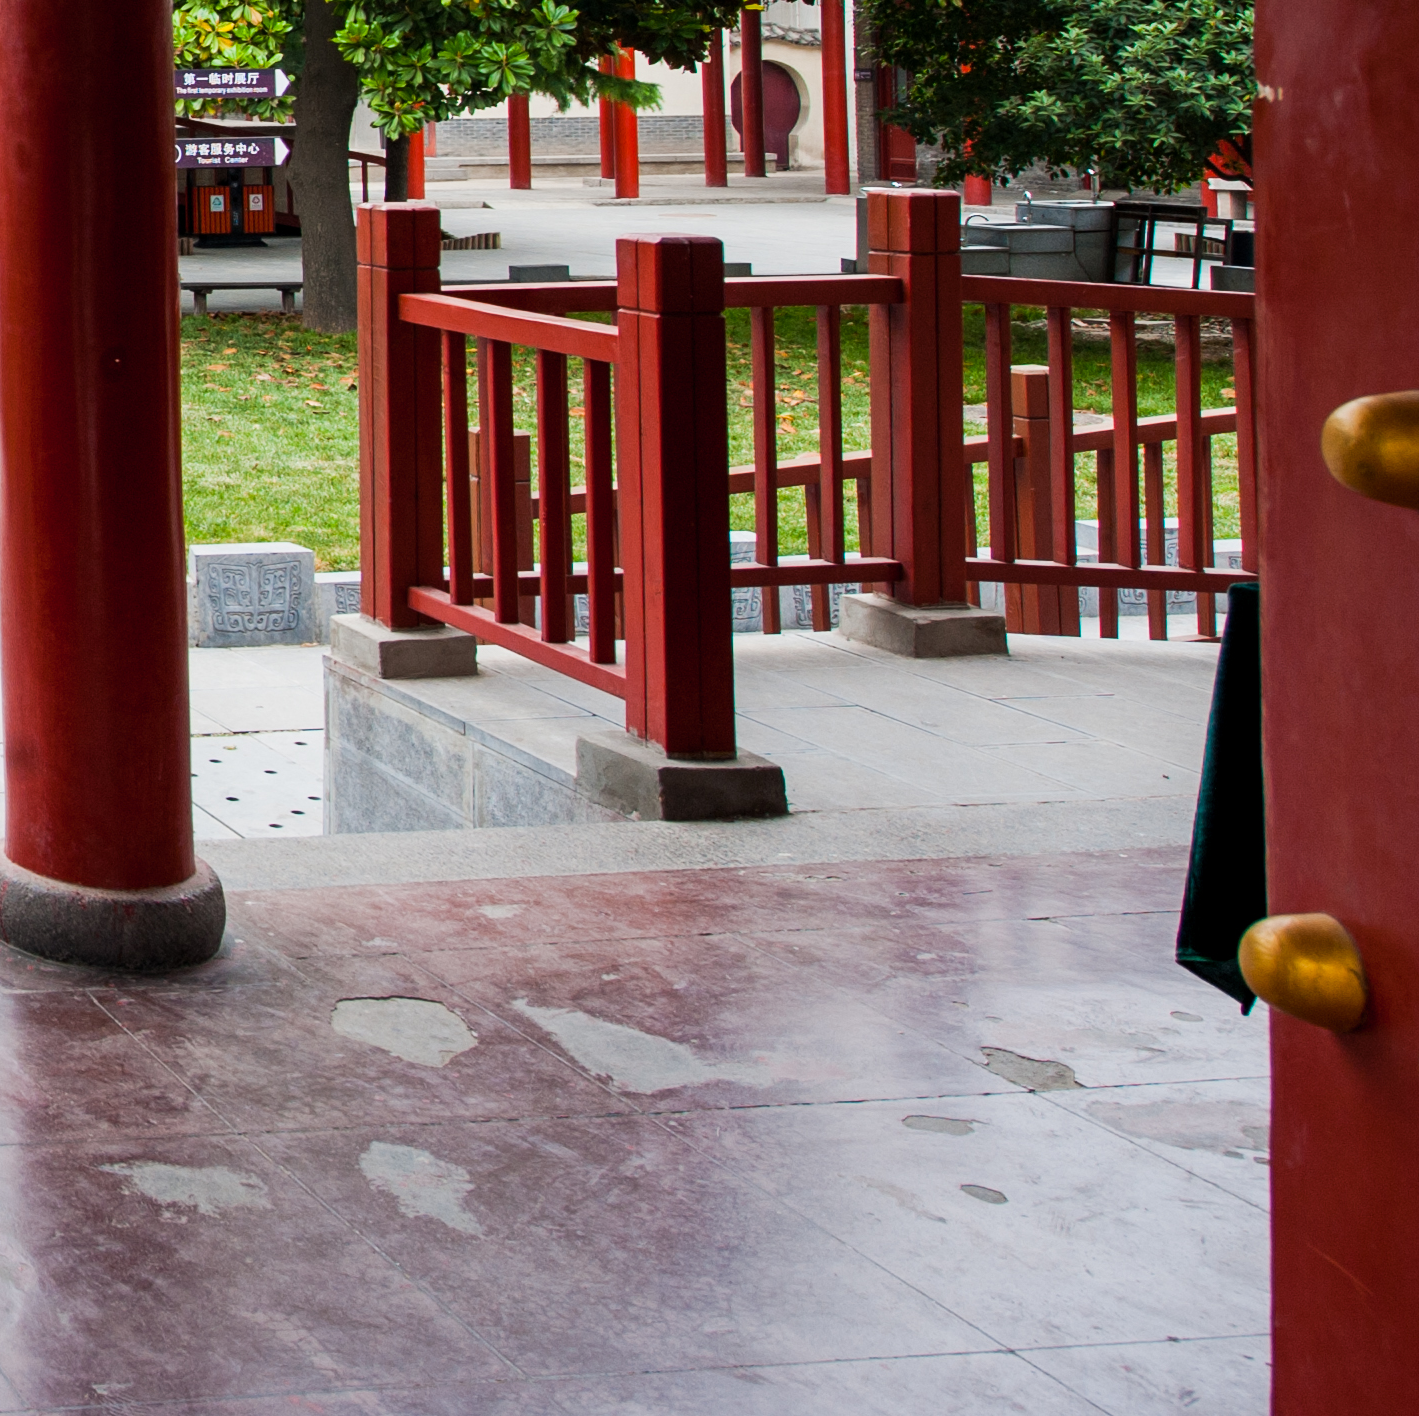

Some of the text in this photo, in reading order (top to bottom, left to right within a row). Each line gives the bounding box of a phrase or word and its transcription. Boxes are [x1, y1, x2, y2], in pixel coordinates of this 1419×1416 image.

[183, 72, 260, 86] 第一临时展厅
[185, 142, 260, 156] 游客服务中心
[197, 156, 249, 165] Tourist Center
